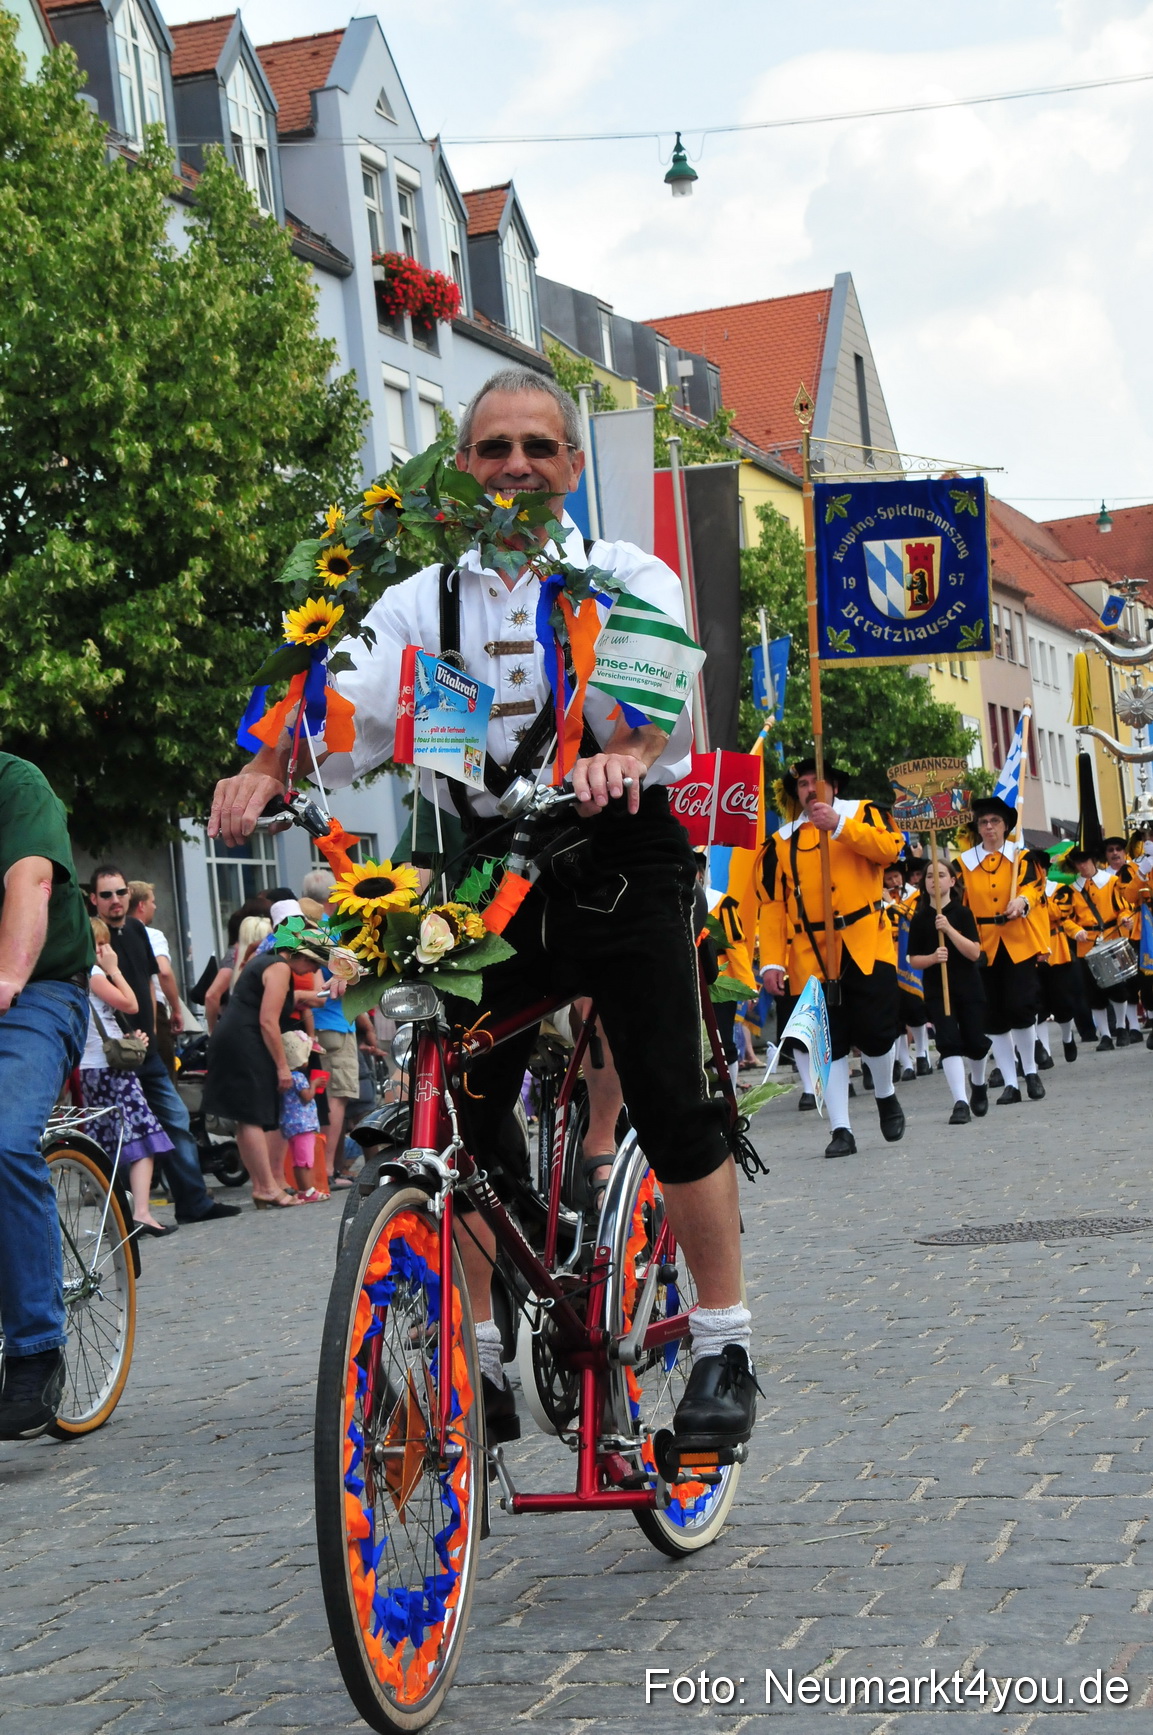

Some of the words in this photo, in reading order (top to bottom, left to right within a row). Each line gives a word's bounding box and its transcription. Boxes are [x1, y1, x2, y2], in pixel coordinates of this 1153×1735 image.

[832, 503, 970, 563] Kolping-Spielmannszug
[842, 576, 857, 590] 19
[840, 601, 967, 642] Beratzhausen
[595, 657, 673, 679] anse-Merkur
[436, 666, 478, 699] Vitakraft
[889, 758, 968, 779] SPIELMANNSZUG
